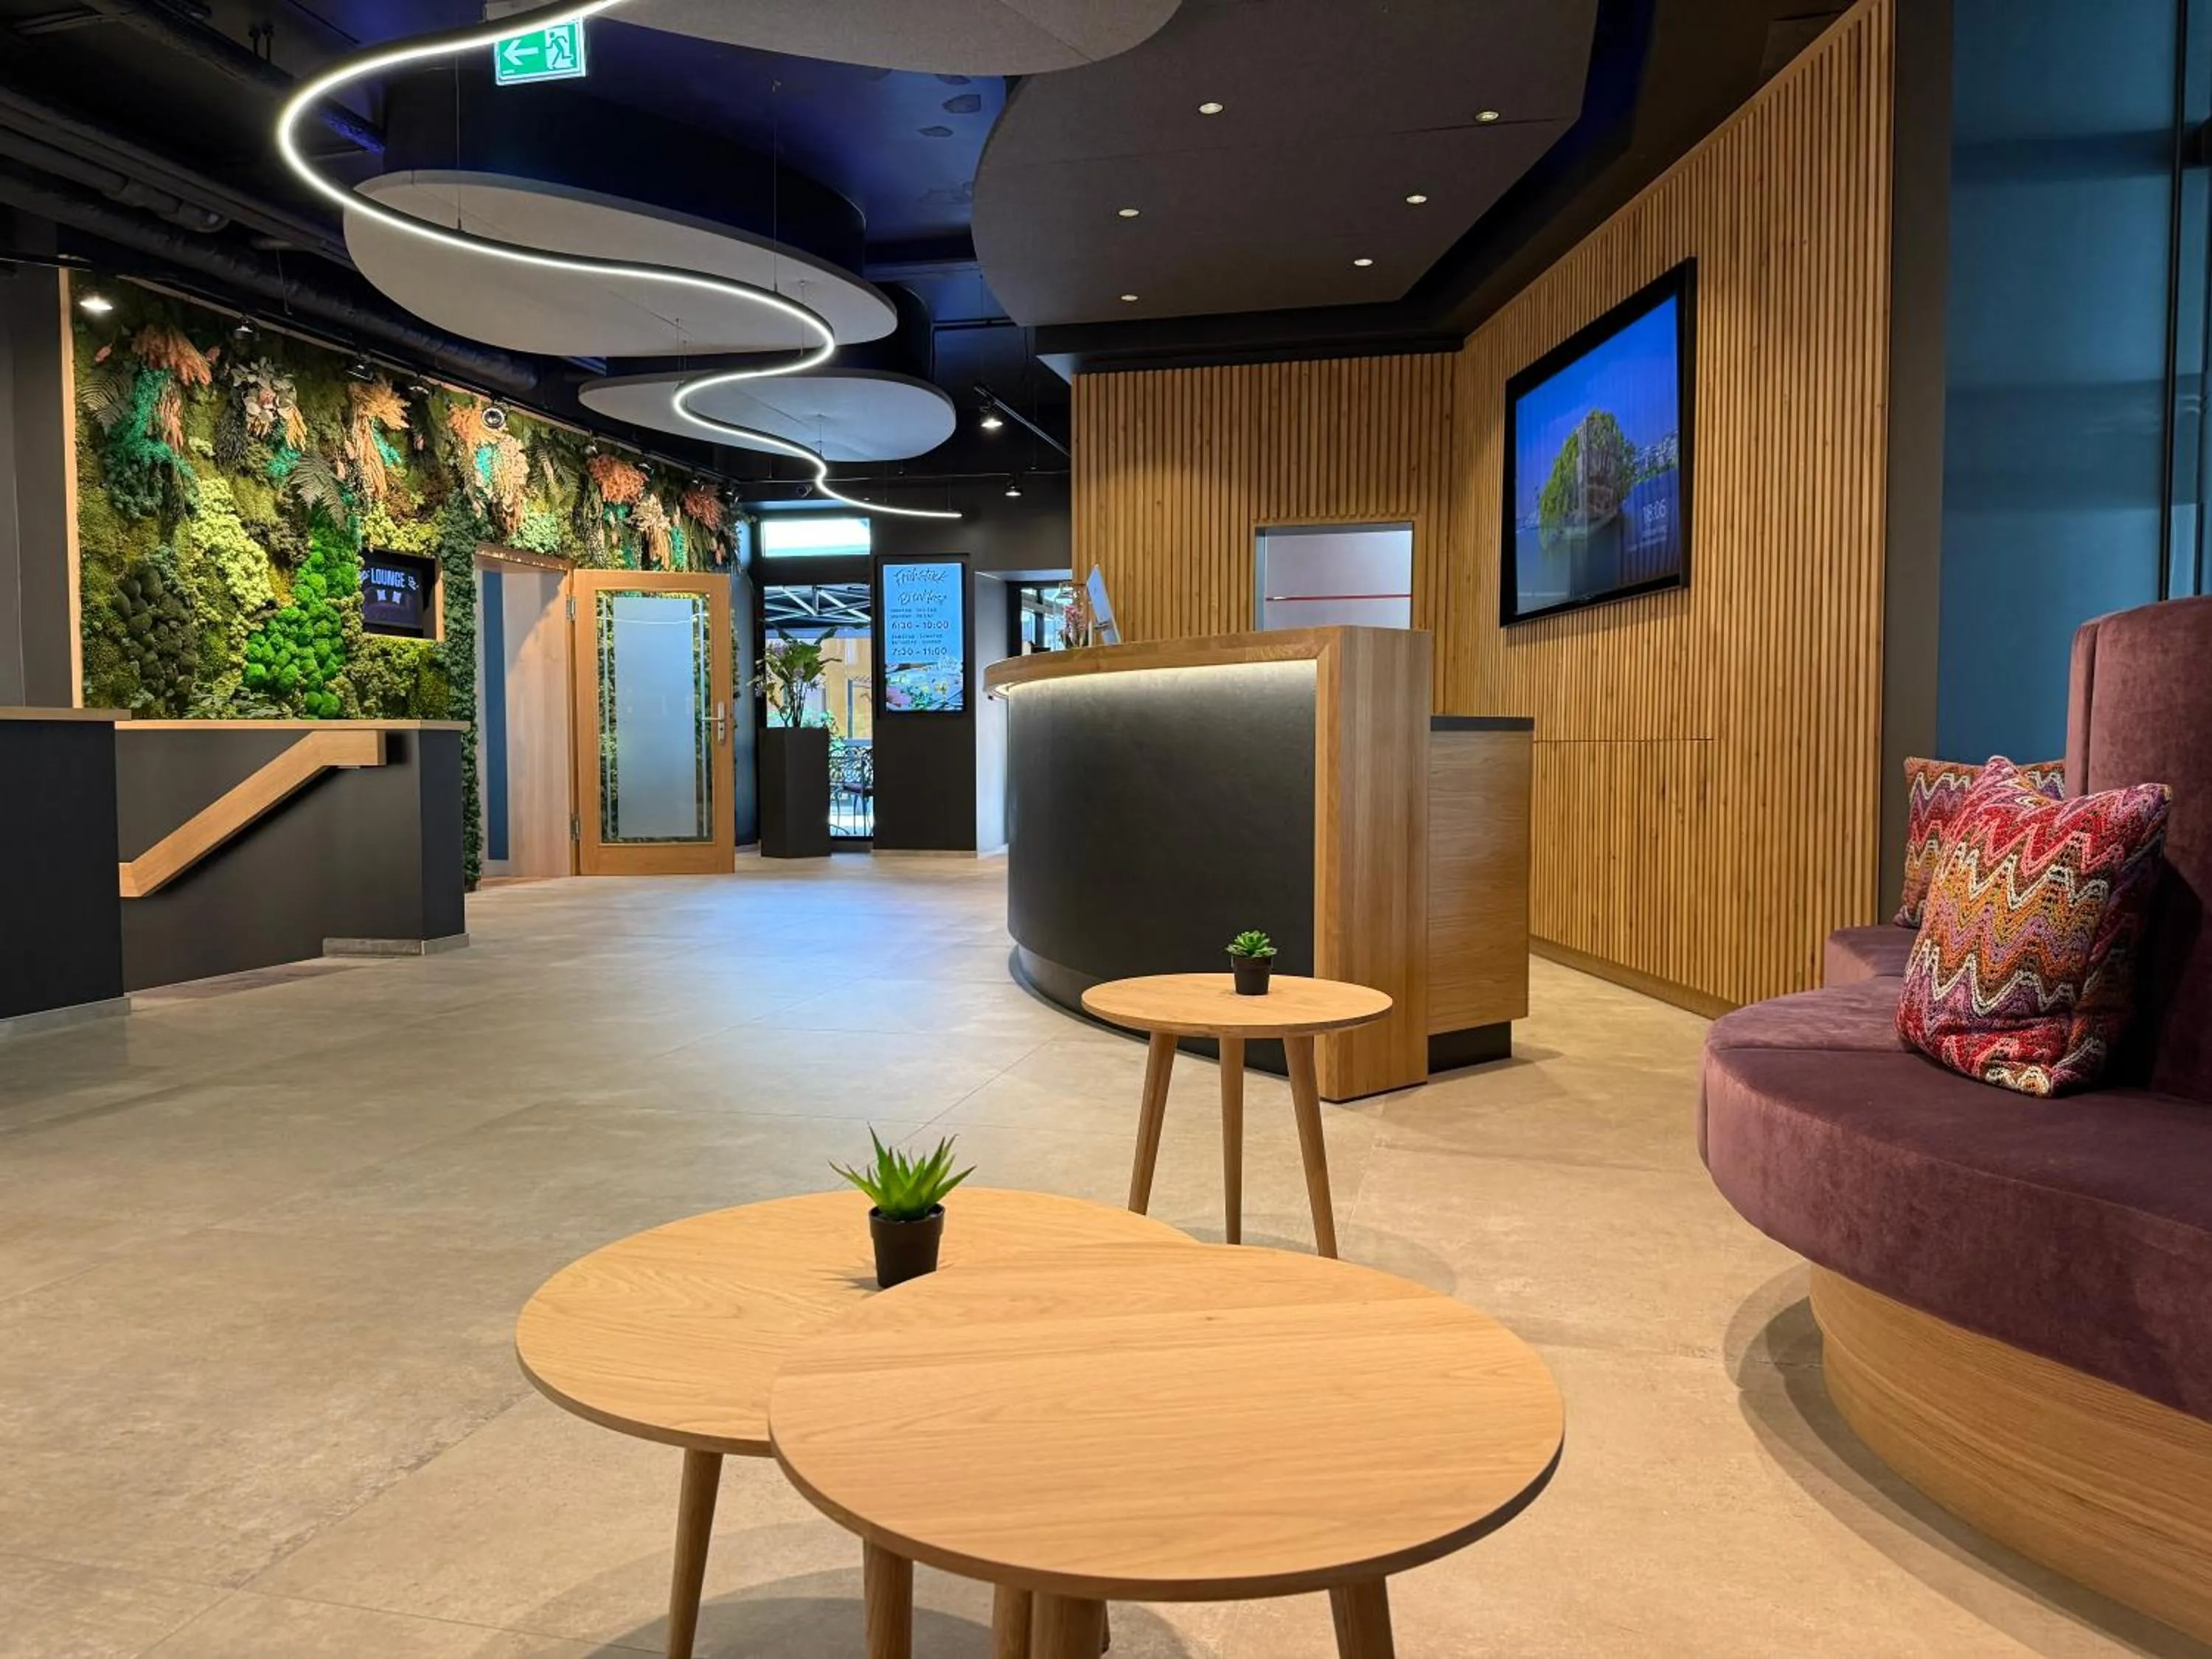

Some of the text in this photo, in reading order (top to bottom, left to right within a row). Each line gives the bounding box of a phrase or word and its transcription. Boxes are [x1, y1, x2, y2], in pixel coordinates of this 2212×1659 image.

[371, 568, 406, 588] LOUNGE
[922, 621, 949, 629] 10:00
[922, 647, 947, 655] 11:00
